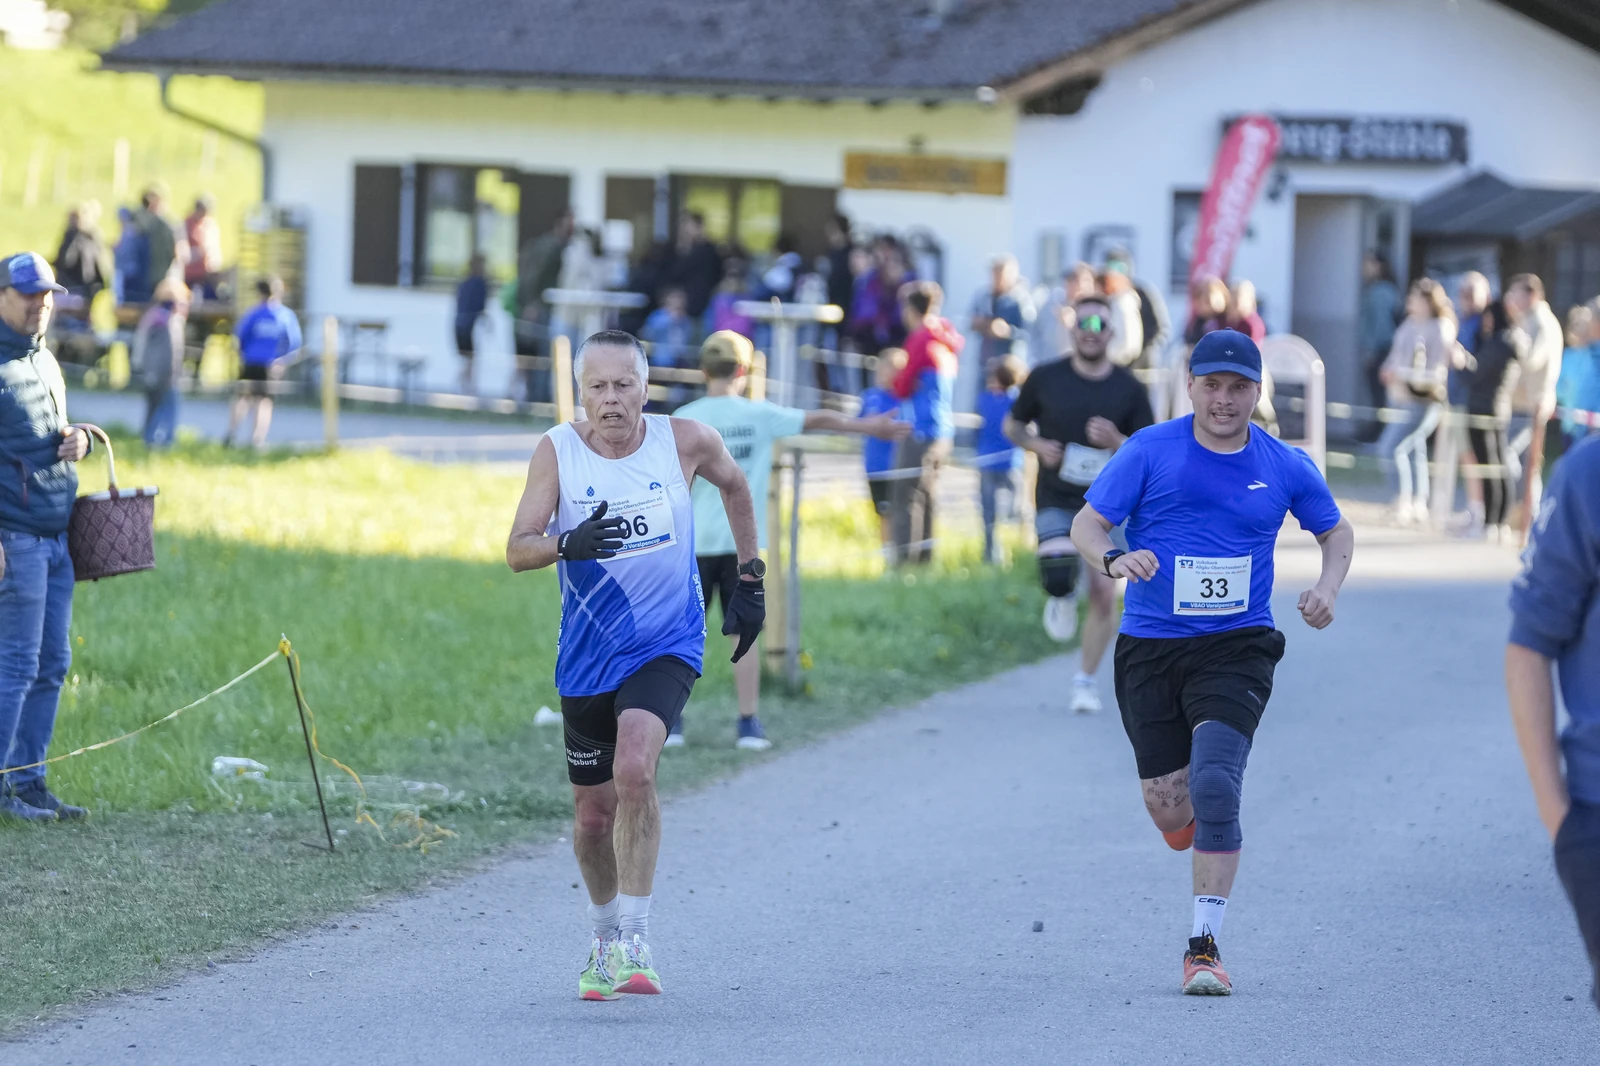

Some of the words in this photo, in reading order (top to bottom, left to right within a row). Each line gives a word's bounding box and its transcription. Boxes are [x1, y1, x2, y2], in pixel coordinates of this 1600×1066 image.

[629, 538, 660, 550] Voralpencup
[1200, 578, 1228, 598] 33
[572, 749, 601, 758] Viktoria
[1199, 897, 1225, 906] cep
